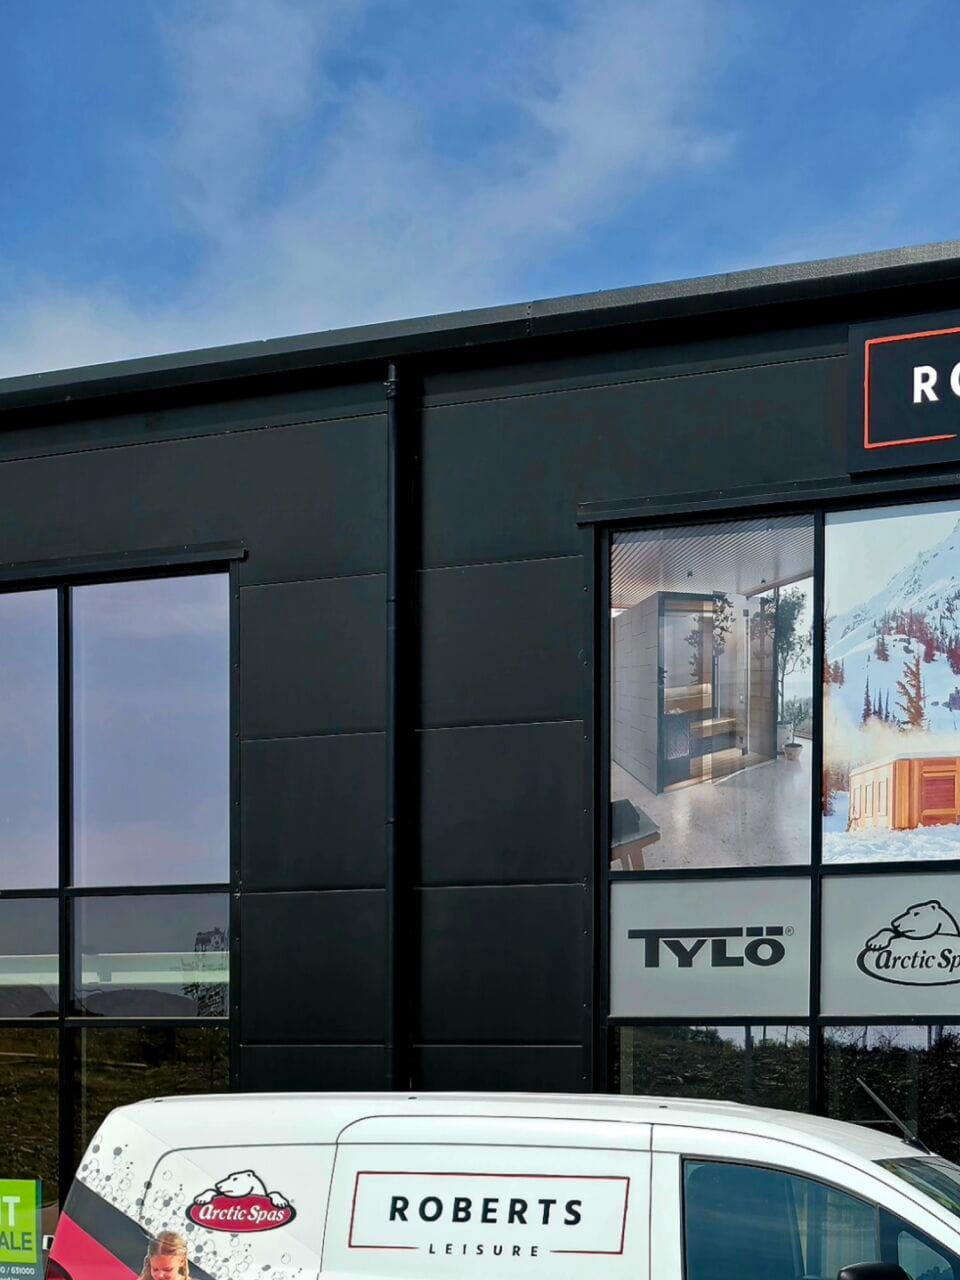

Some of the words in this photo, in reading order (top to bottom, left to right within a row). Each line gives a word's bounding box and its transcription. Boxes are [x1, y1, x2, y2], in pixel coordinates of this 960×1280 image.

[0, 1195, 20, 1227] T
[247, 1205, 285, 1224] Spas
[389, 1196, 582, 1226] ROBERTS
[429, 1243, 538, 1257] LEISURE
